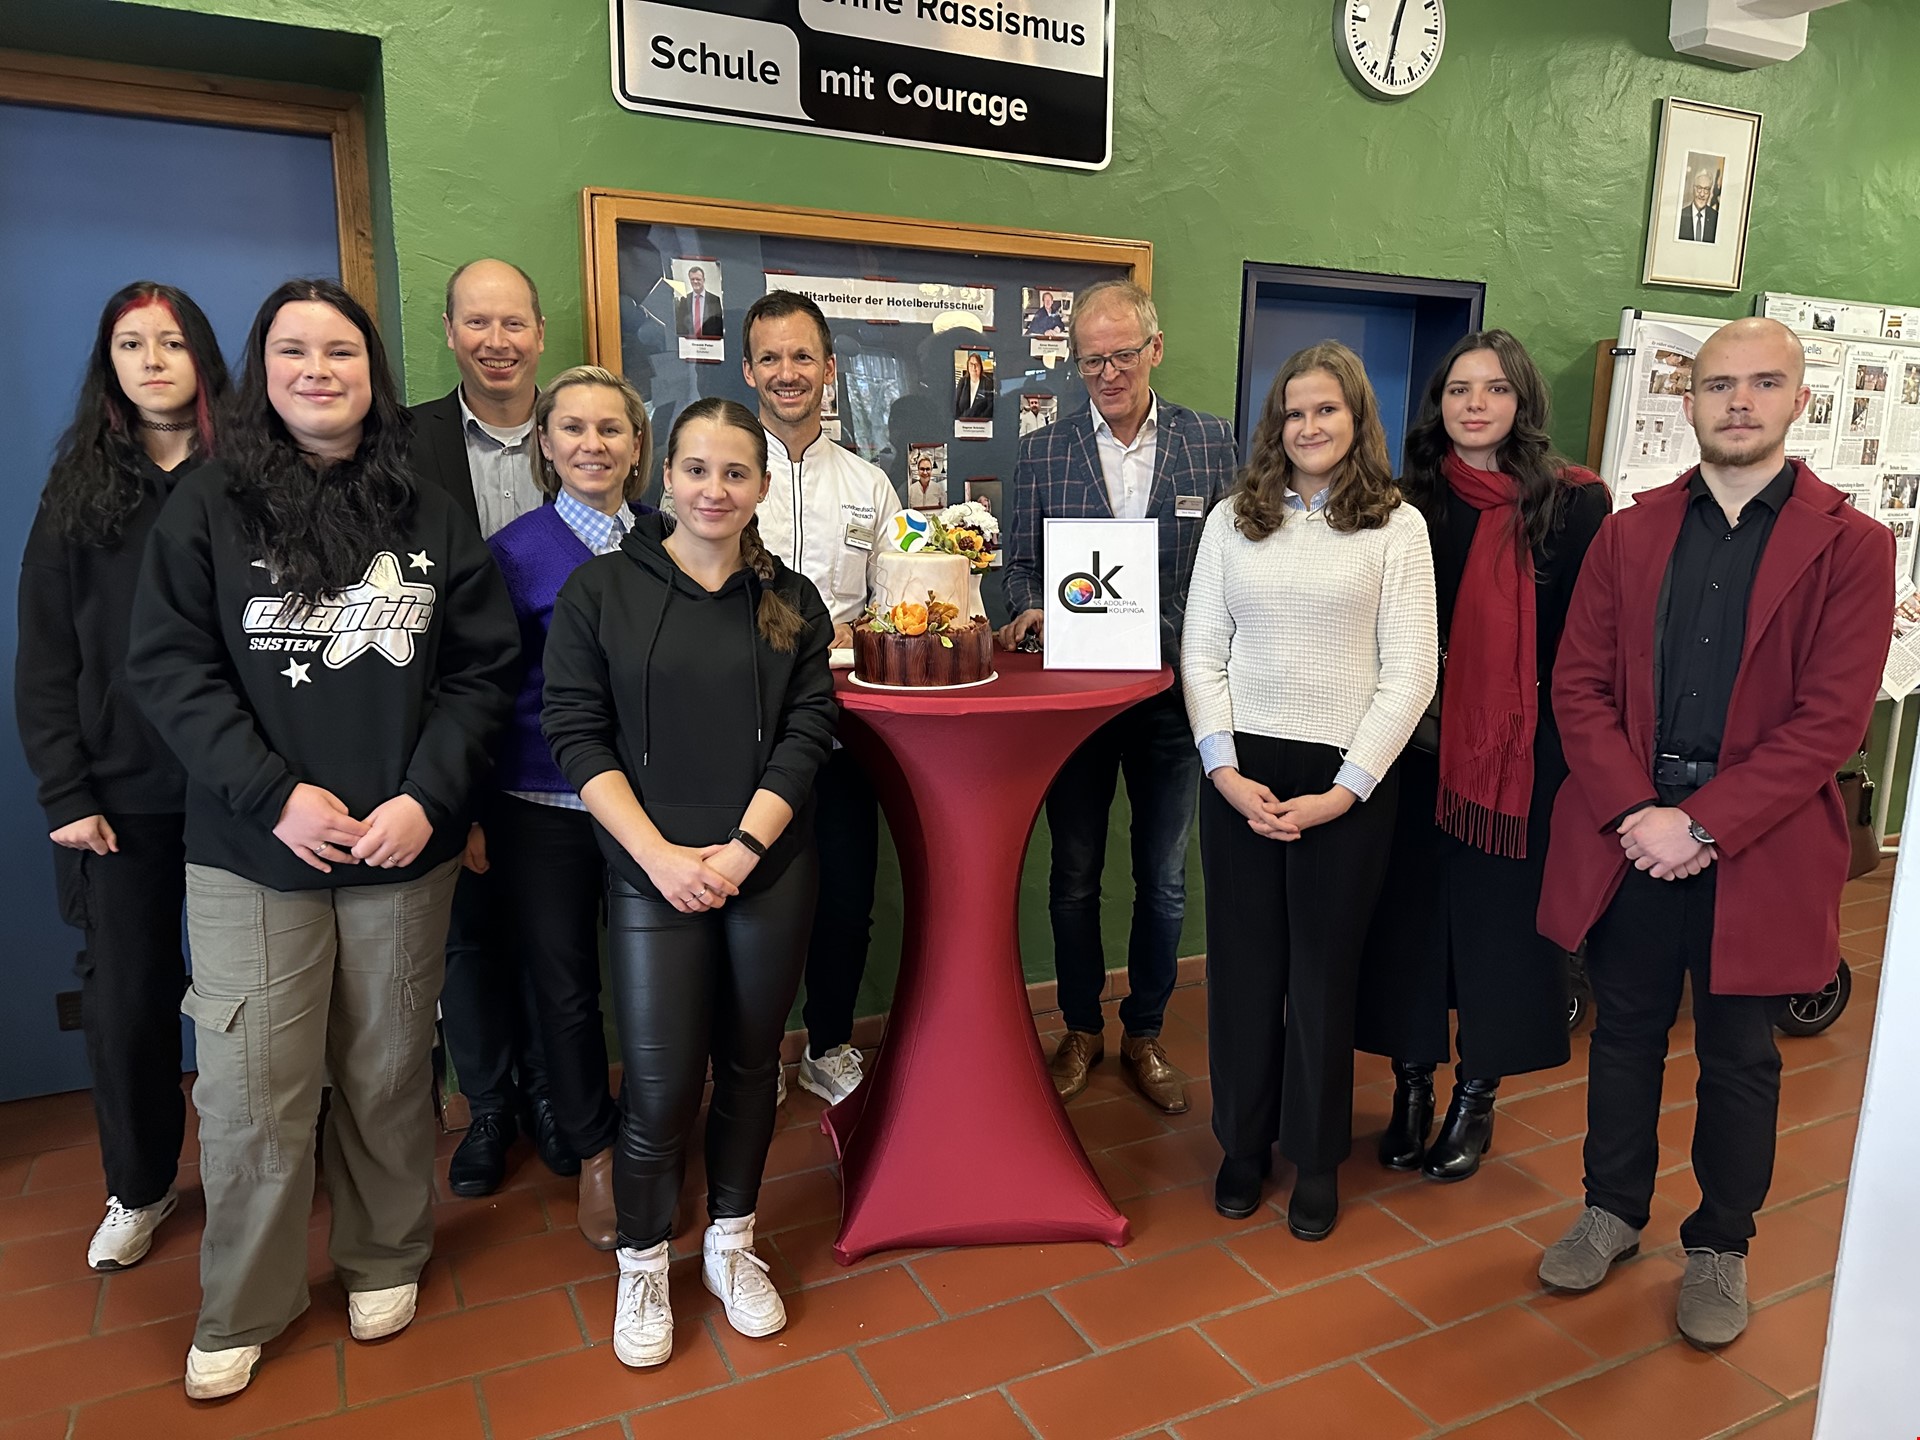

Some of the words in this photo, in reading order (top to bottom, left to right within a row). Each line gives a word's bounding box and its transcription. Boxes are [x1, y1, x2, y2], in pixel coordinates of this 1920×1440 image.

[917, 0, 1086, 46] Rassismus
[650, 35, 781, 85] Schule
[820, 65, 875, 100] mit
[887, 72, 1028, 126] Courage
[865, 295, 884, 306] der
[887, 297, 984, 311] Hotelberufsschule
[249, 637, 322, 652] SYSTEM
